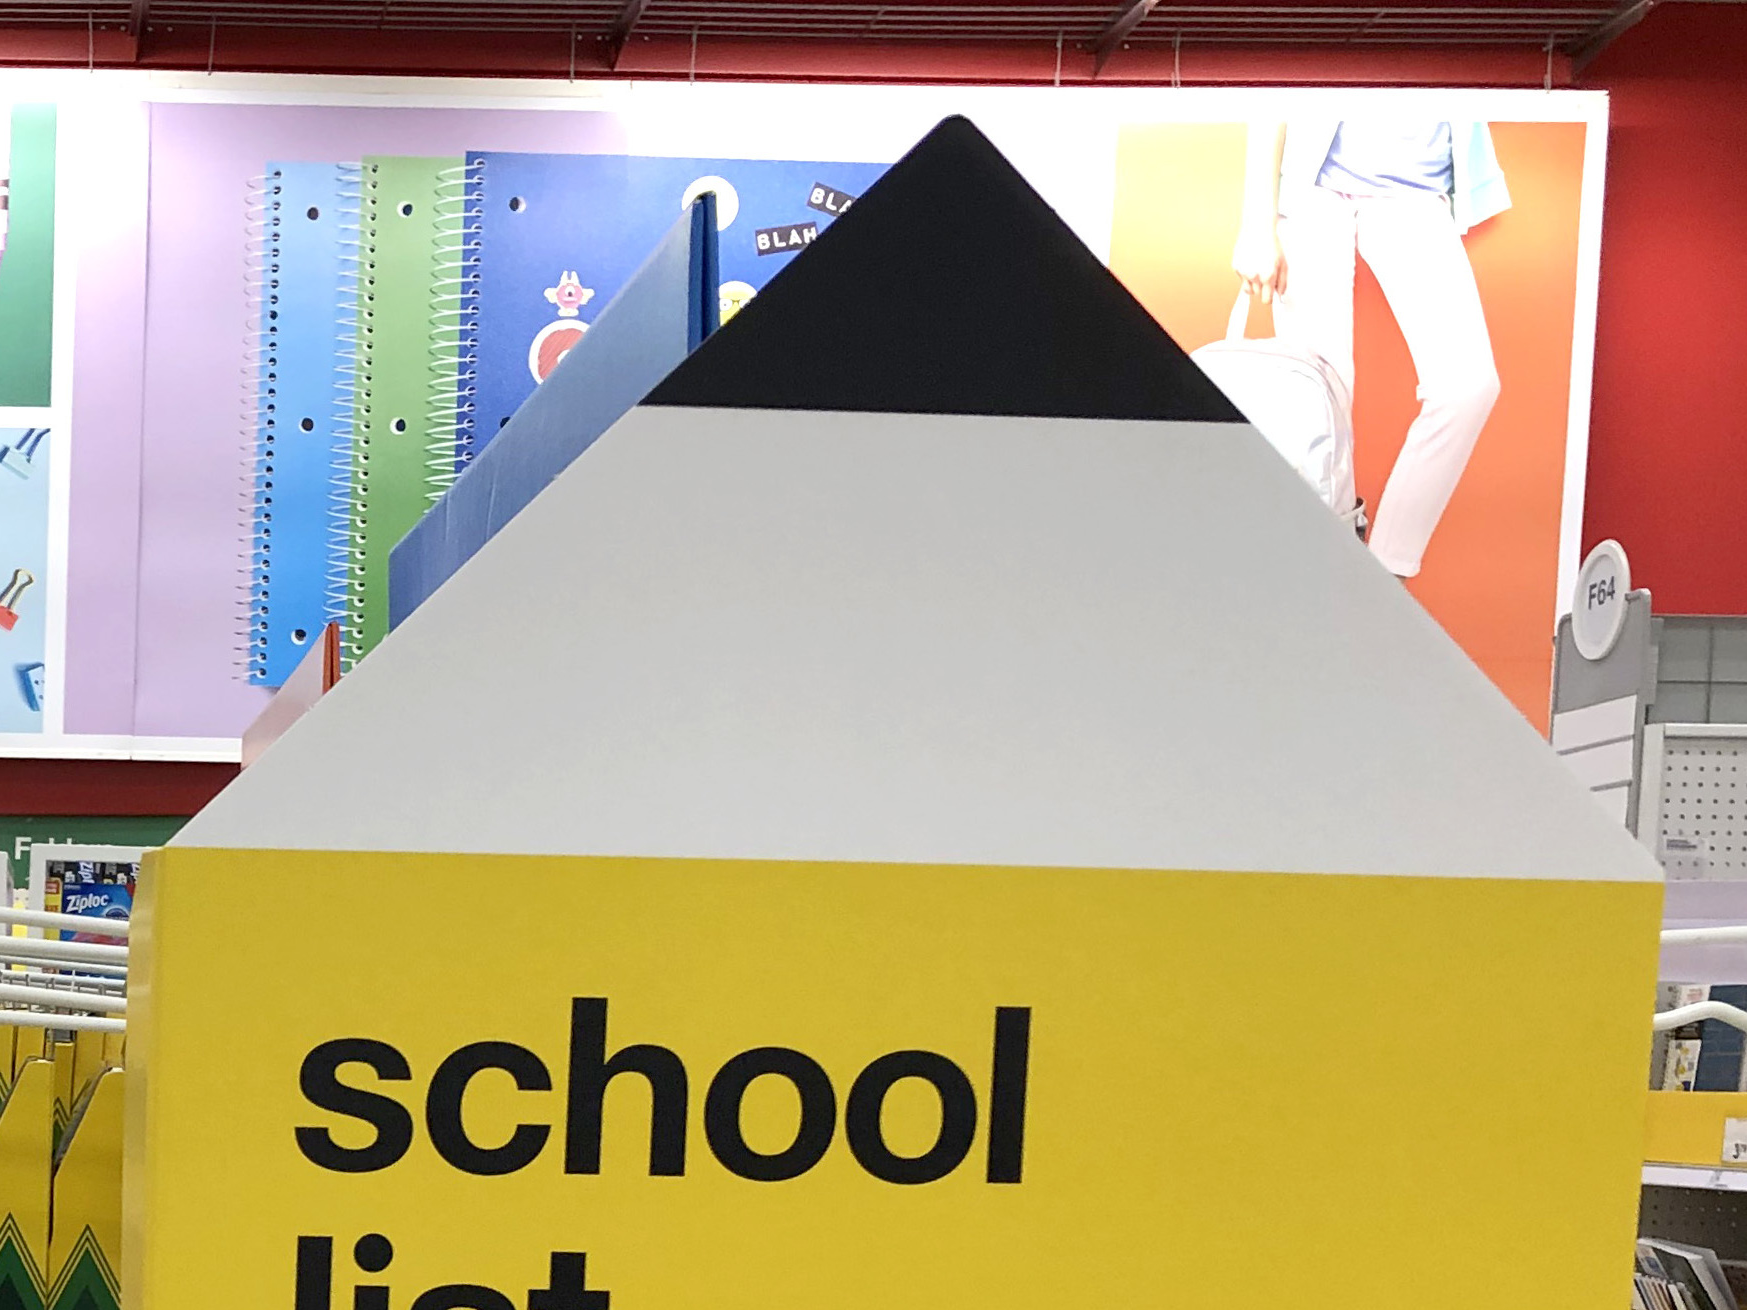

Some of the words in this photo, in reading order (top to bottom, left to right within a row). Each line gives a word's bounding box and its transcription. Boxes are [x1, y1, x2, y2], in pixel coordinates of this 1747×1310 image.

[756, 226, 817, 250] BLAH
[1587, 576, 1616, 610] F64
[66, 893, 109, 913] Ziploc
[294, 997, 1032, 1185] school
